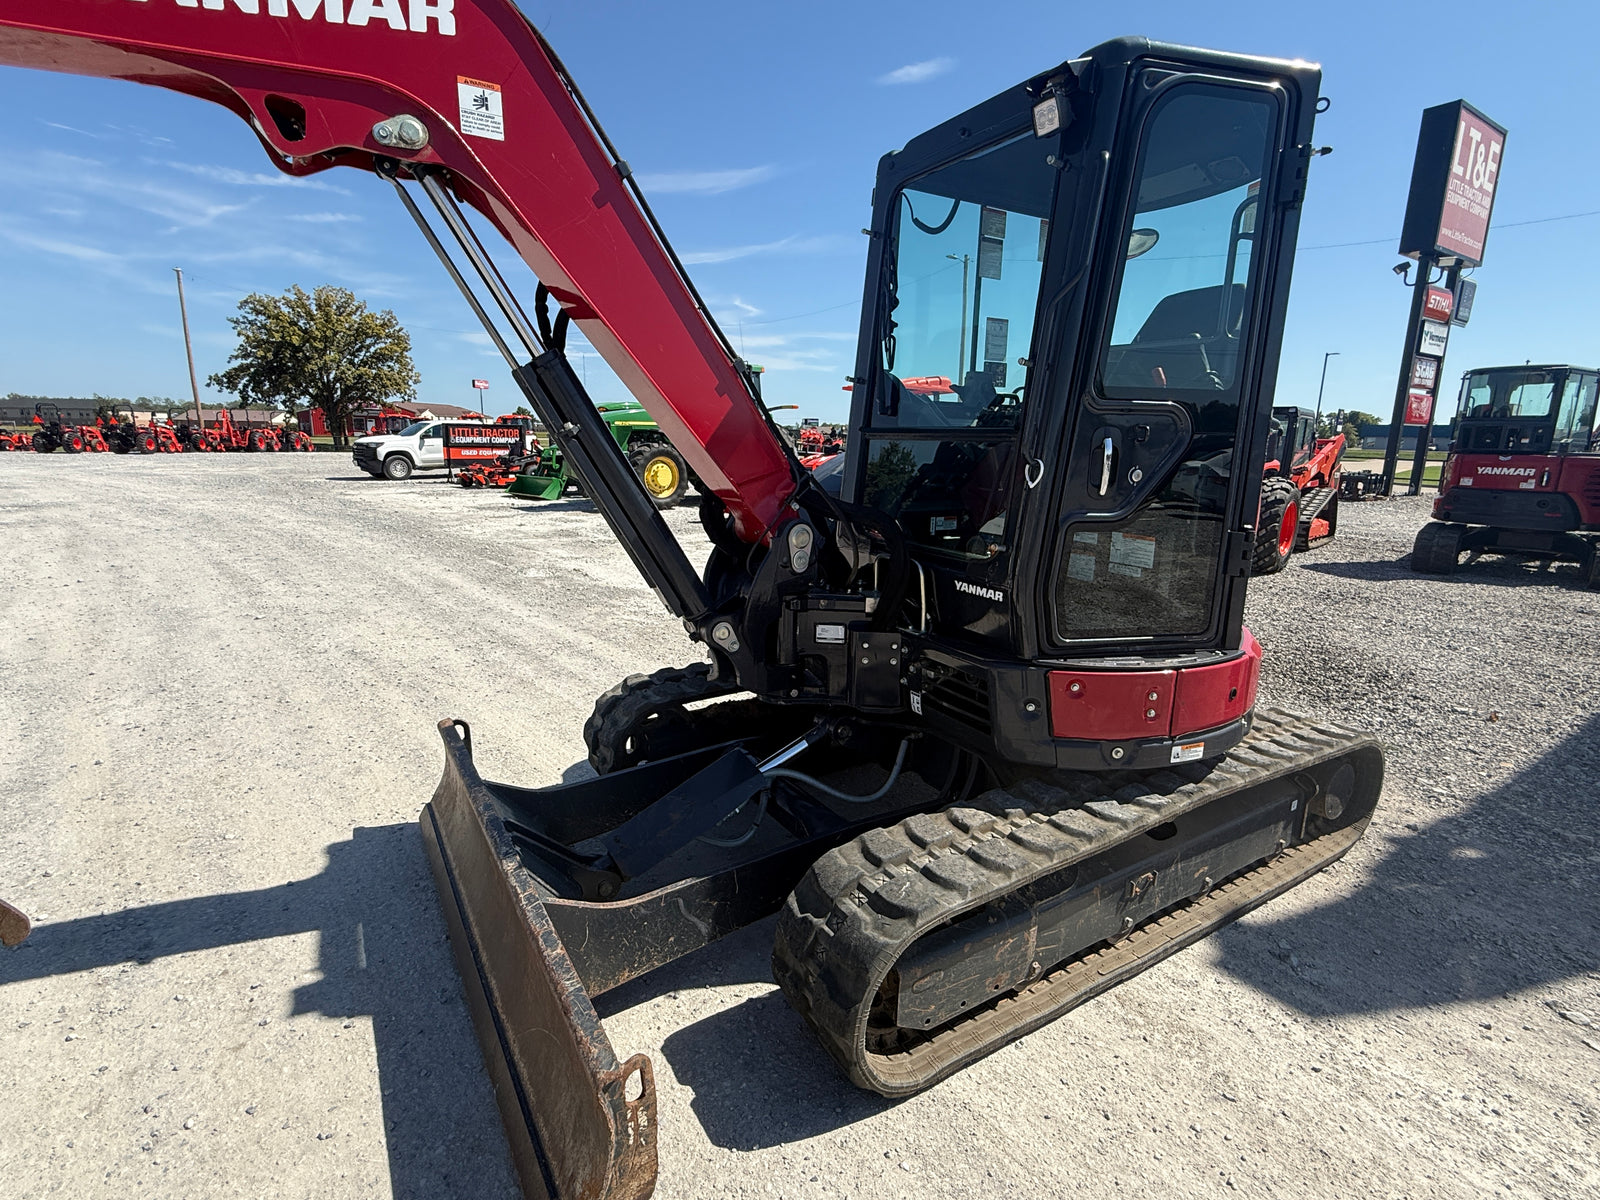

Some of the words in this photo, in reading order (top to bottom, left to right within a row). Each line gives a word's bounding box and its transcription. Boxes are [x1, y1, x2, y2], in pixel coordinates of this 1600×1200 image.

[125, 0, 457, 36] MAR
[1452, 120, 1500, 193] LT&E
[1428, 295, 1450, 312] STIHL
[449, 427, 479, 437] LITTLE
[481, 428, 520, 438] TRACTOR
[1476, 466, 1536, 476] YANMAR
[954, 580, 1003, 602] YANMAR
